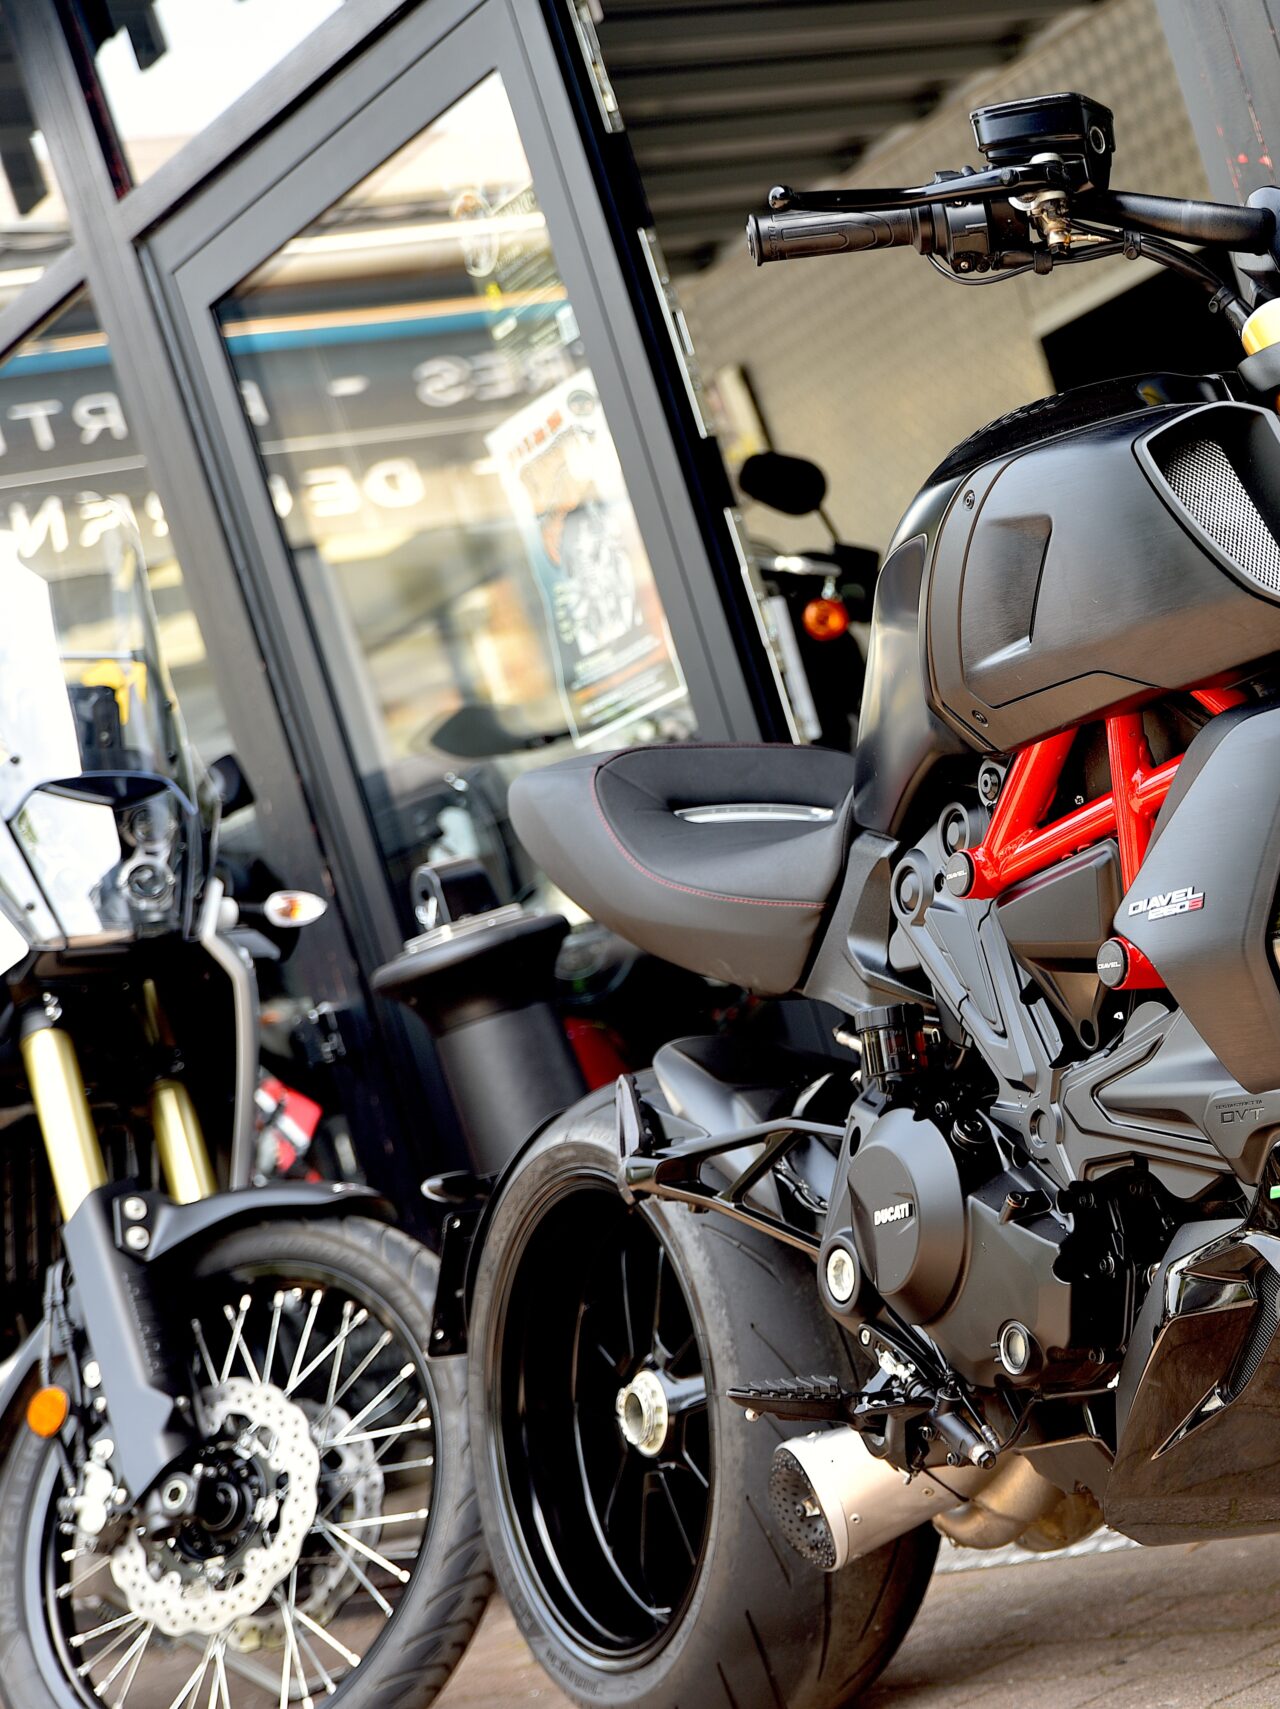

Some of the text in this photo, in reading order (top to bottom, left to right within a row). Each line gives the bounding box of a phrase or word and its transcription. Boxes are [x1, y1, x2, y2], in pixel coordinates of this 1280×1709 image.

[1128, 886, 1205, 917] DIAVEL
[1220, 1107, 1265, 1124] DVT
[873, 1202, 910, 1226] DUCATI
